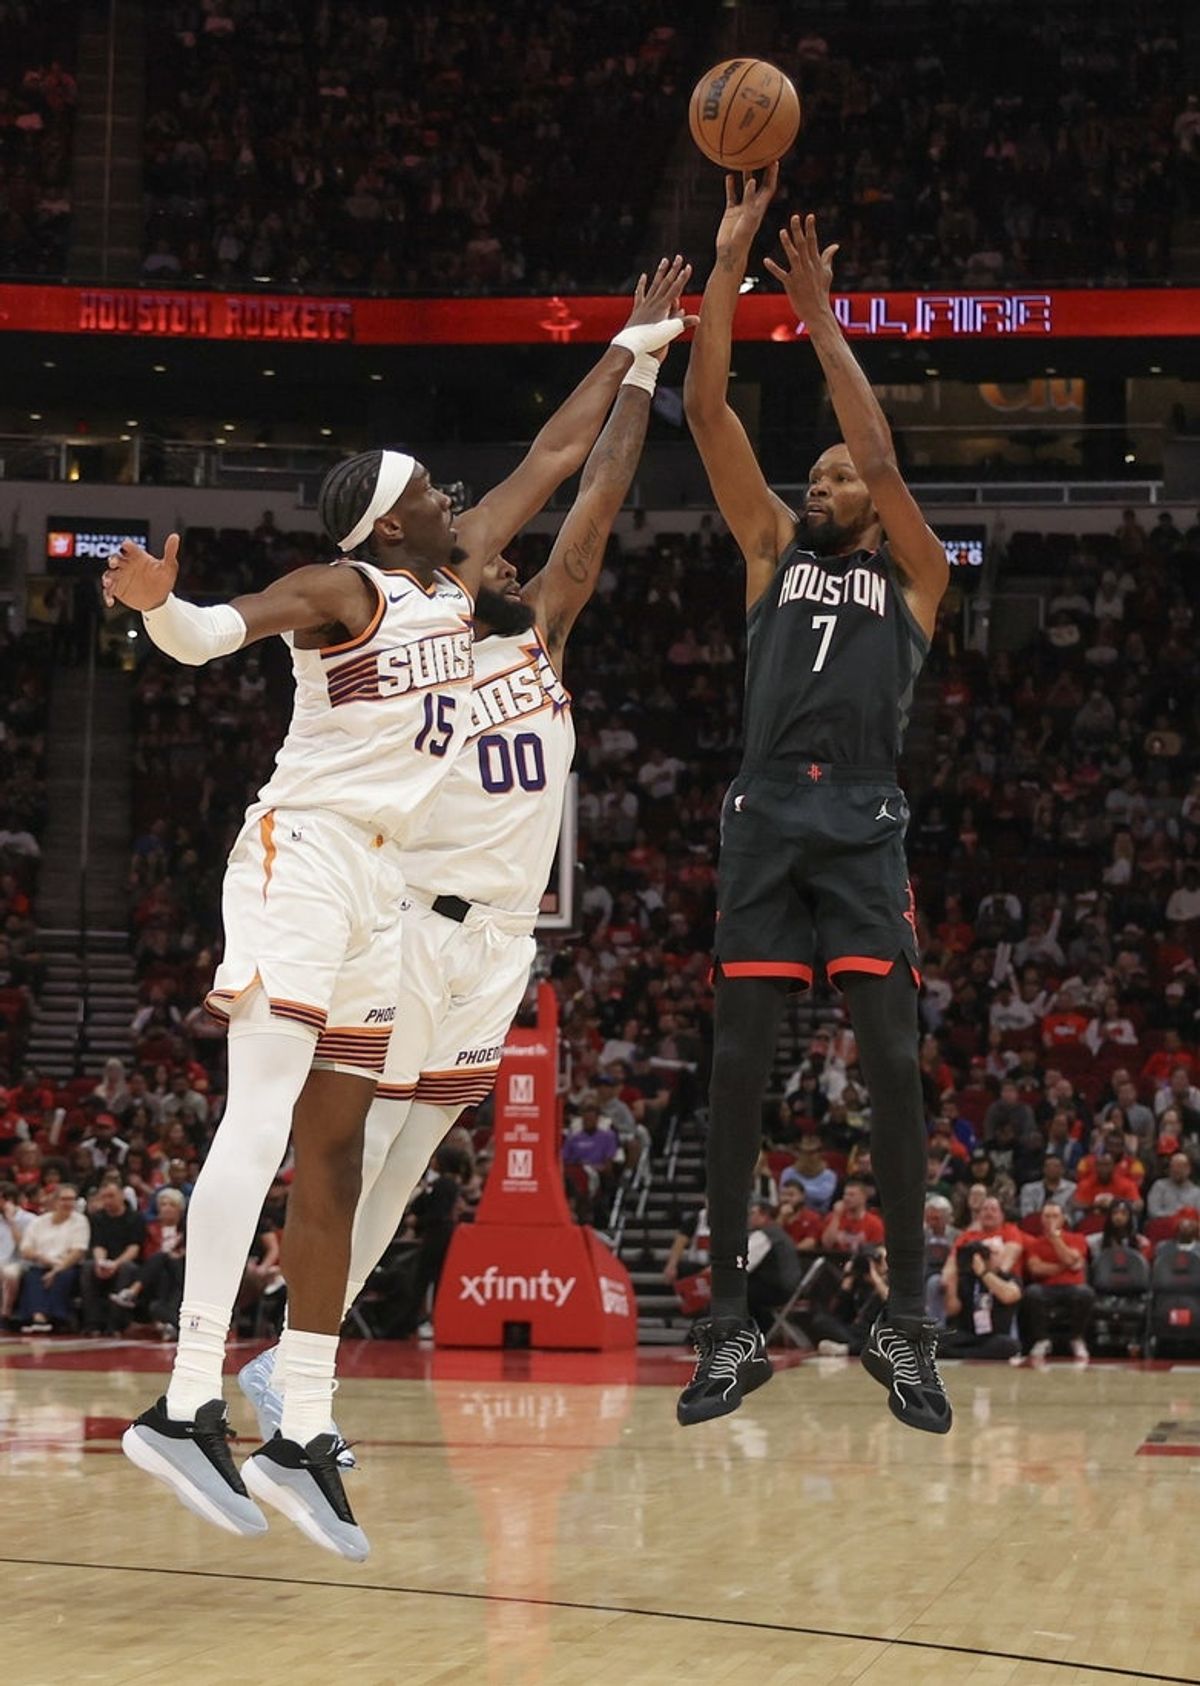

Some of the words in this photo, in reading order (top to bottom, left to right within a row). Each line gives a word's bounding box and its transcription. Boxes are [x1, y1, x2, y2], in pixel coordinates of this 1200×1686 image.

[777, 562, 886, 617] HOUSTON
[811, 615, 837, 672] 7
[414, 692, 456, 758] 15
[477, 732, 547, 794] 00
[459, 1265, 577, 1308] xfinity
